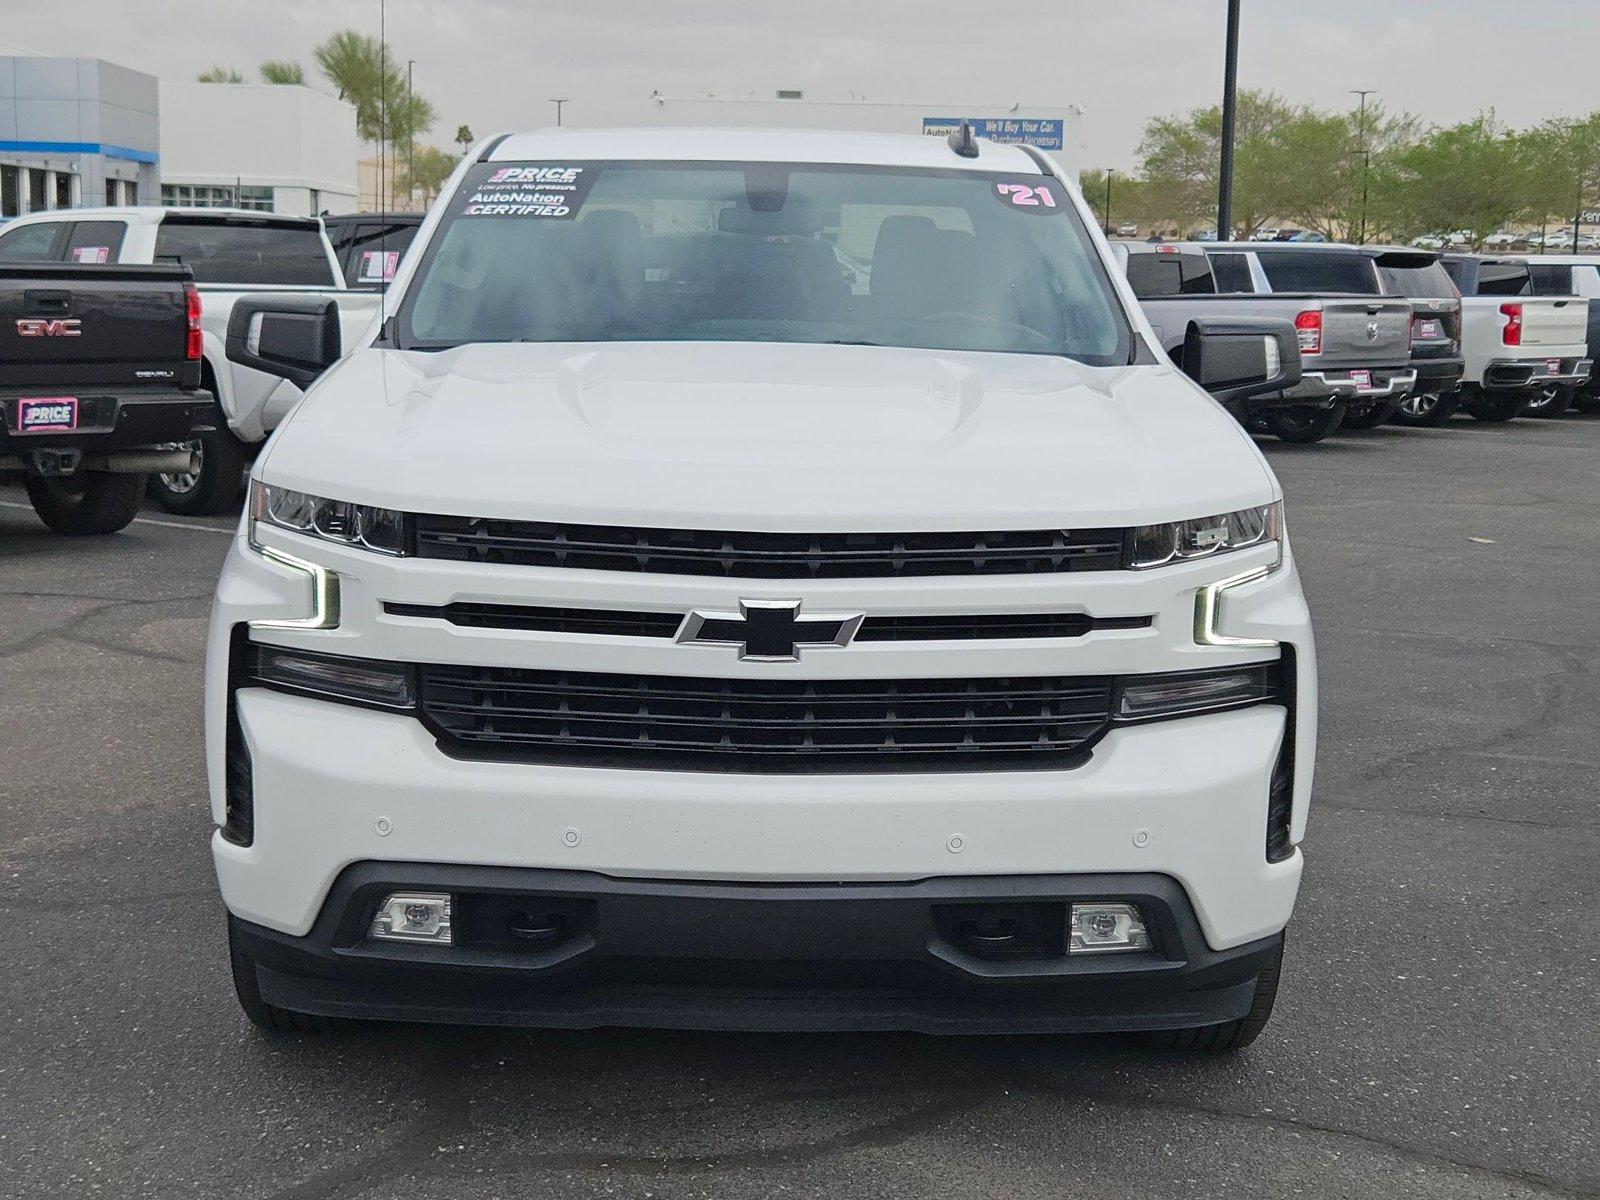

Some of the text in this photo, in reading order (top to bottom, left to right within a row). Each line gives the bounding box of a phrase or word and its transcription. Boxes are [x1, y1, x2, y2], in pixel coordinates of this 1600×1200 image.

[986, 120, 1056, 134] We'll Buy Your Car.
[469, 192, 565, 203] AutoNation
[468, 205, 570, 216] CERTIFIED
[16, 319, 82, 337] GMC
